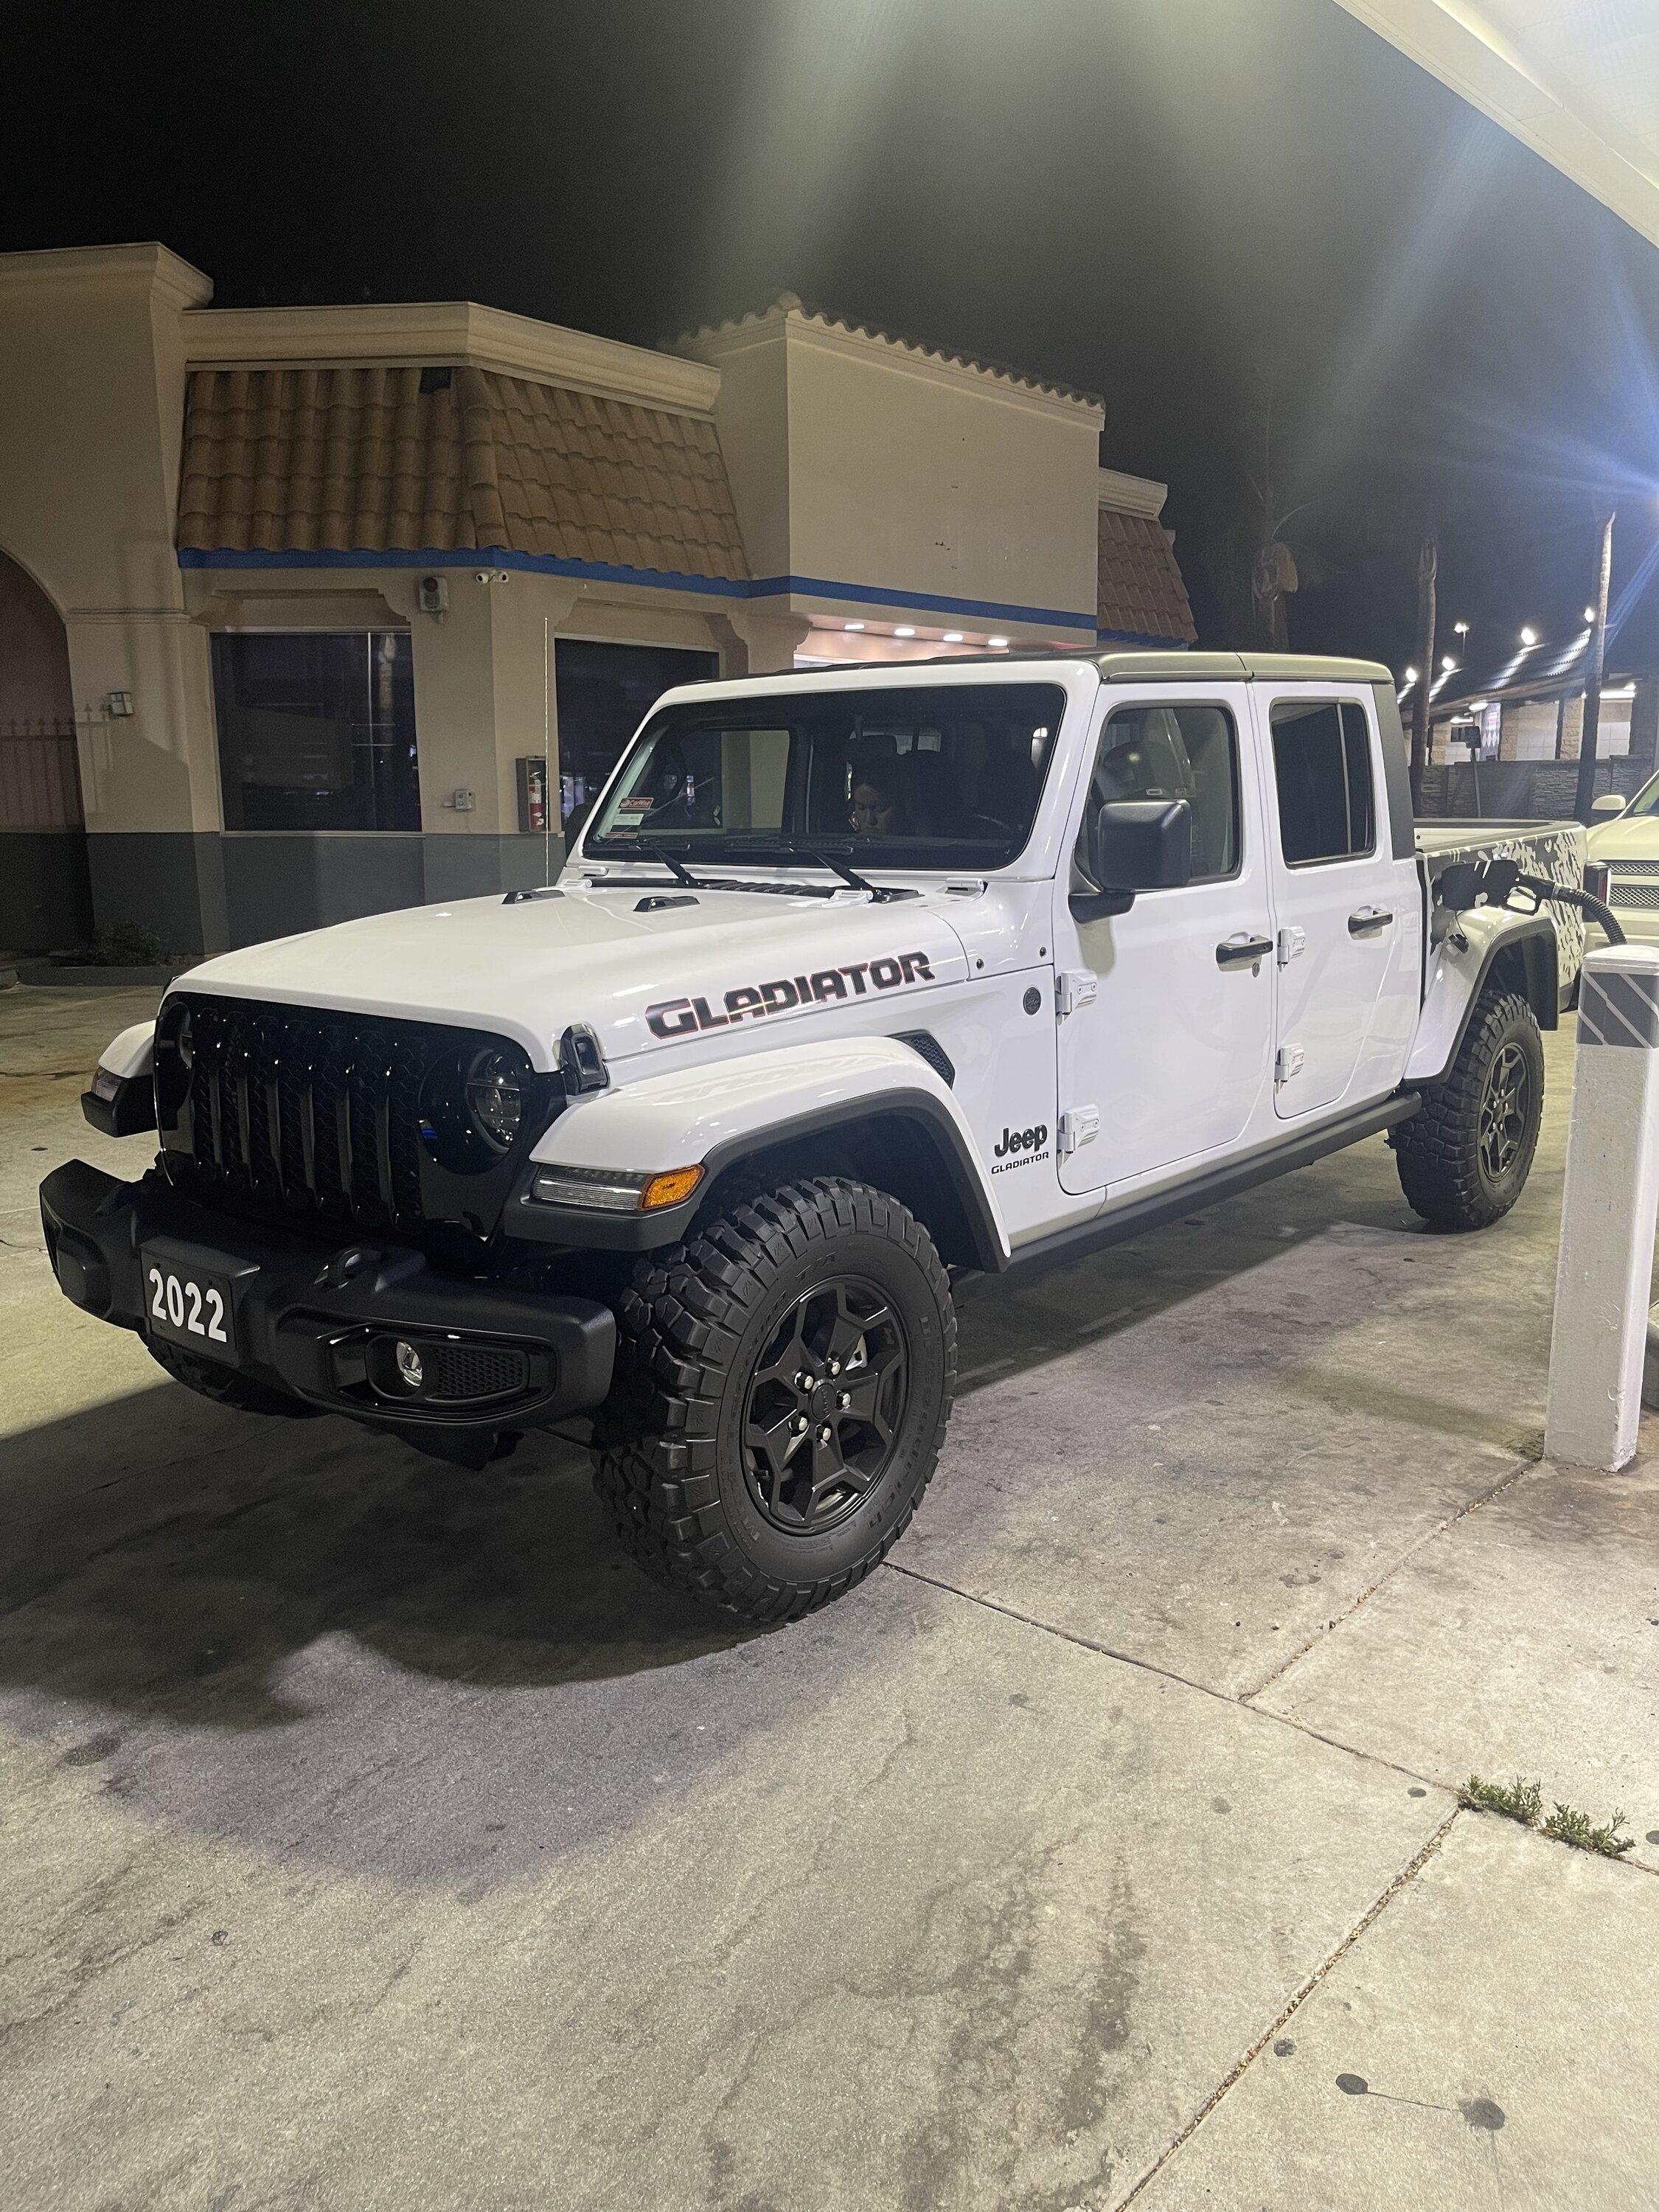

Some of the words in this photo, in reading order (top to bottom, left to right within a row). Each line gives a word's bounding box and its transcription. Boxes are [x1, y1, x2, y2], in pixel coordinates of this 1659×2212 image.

[644, 950, 936, 1040] GLADIATOR
[991, 1151, 1049, 1175] GLADIATOR
[994, 1124, 1048, 1157] Jeep
[149, 1268, 227, 1343] 2022
